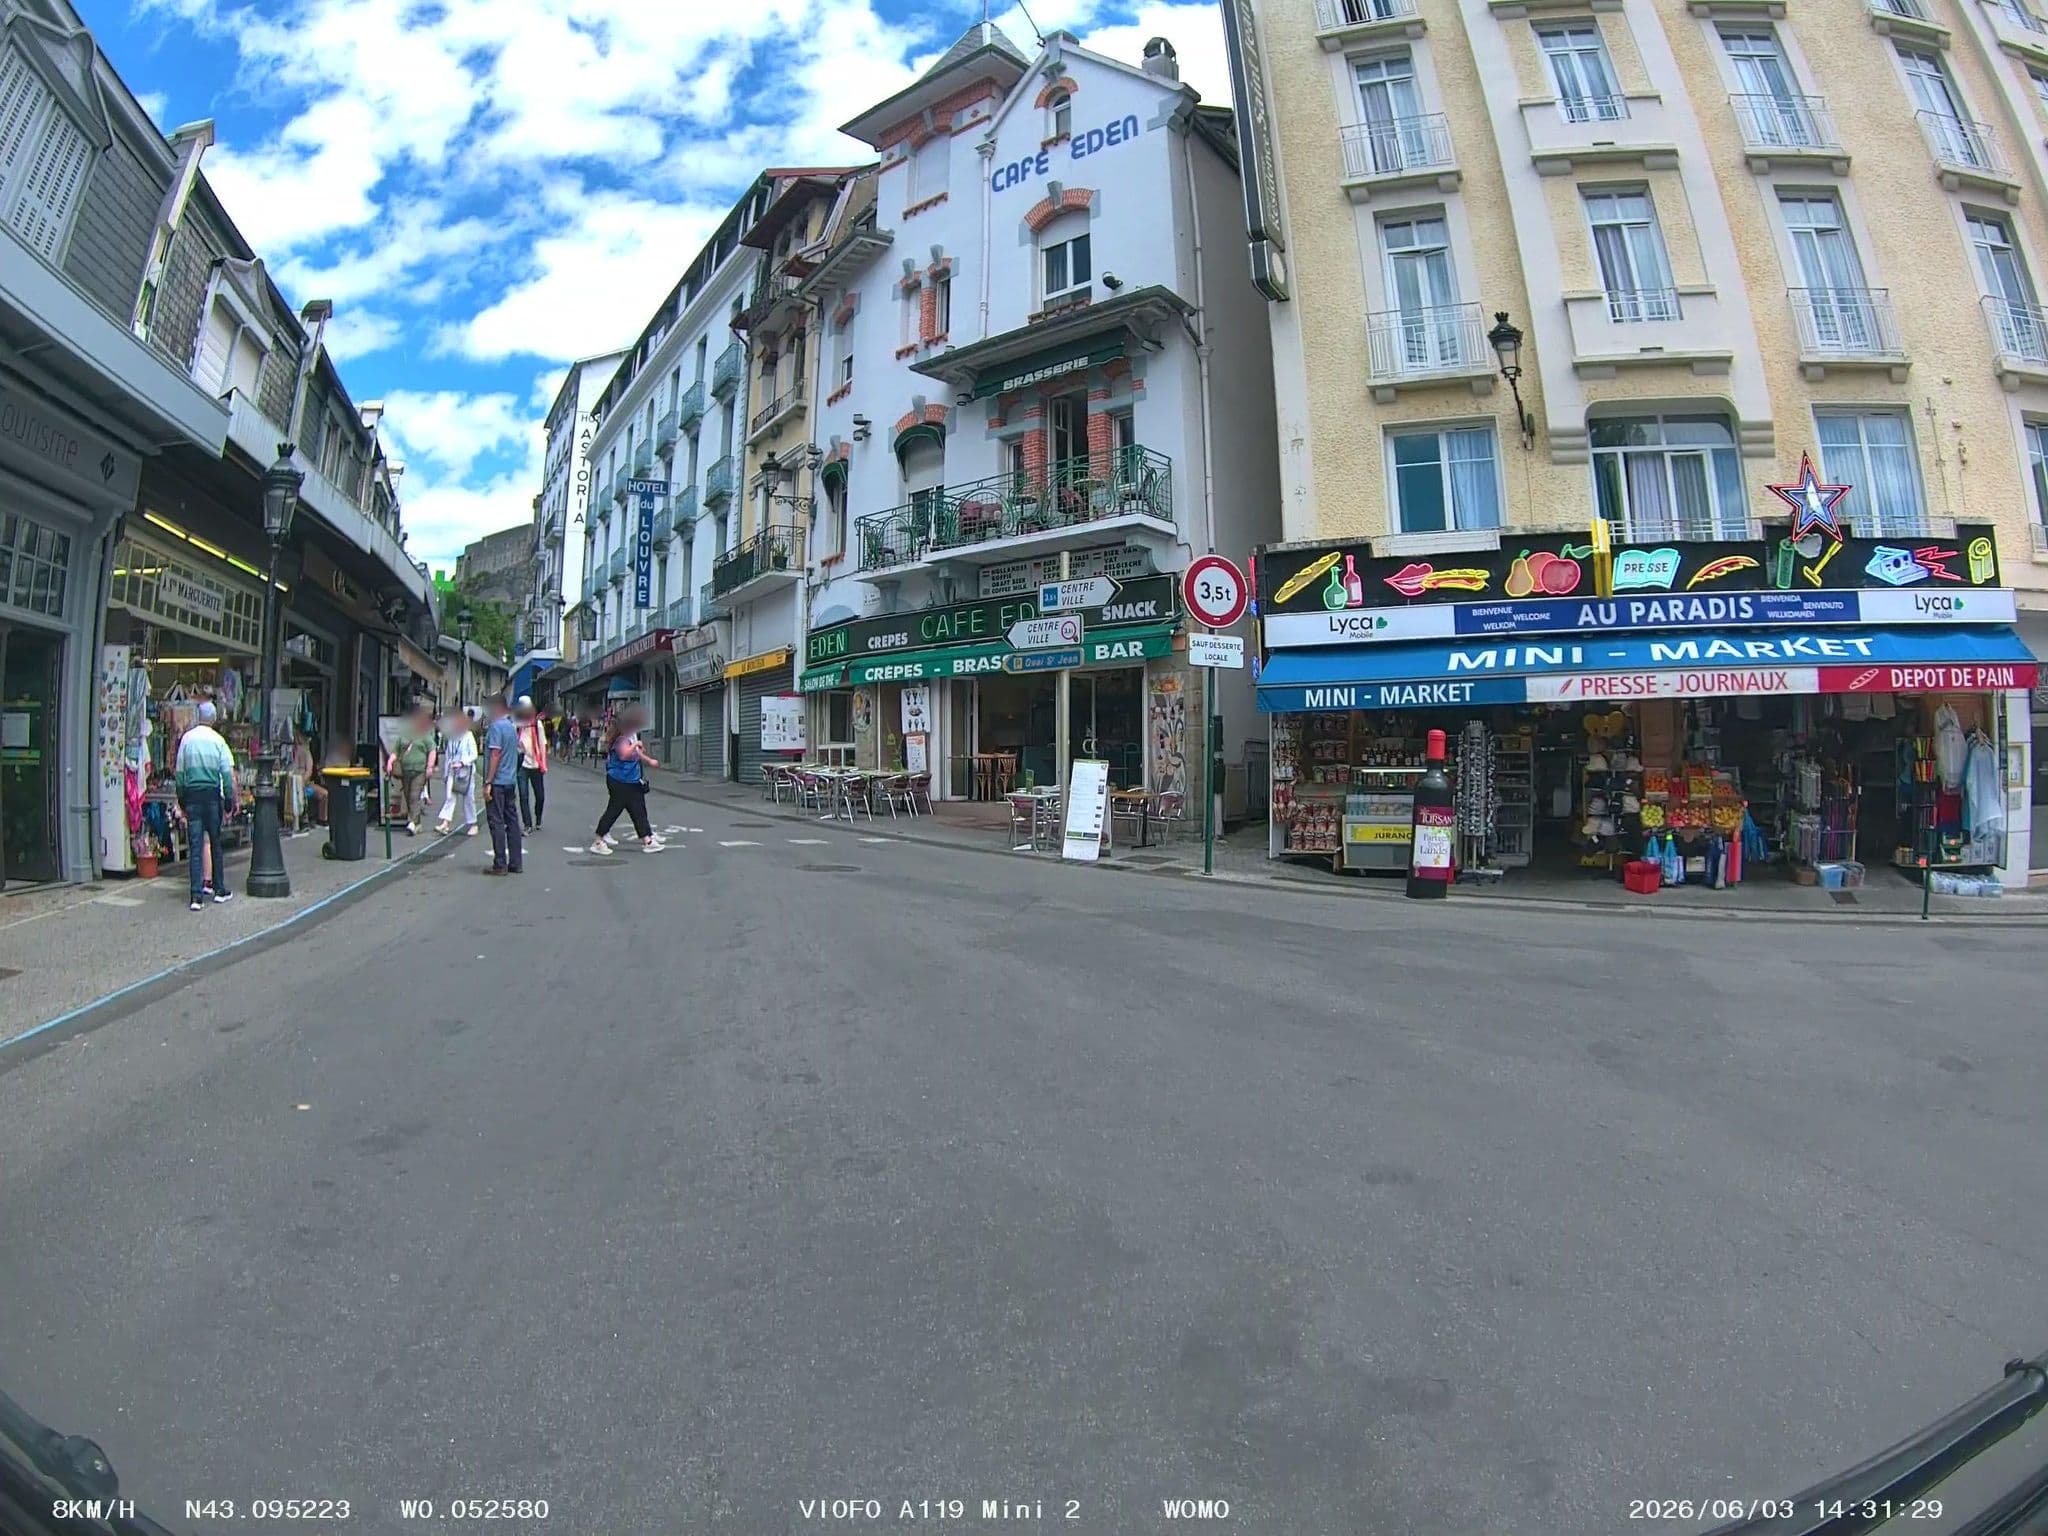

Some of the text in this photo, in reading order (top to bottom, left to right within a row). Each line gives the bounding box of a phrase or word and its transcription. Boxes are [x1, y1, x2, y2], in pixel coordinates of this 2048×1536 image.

[1071, 115, 1139, 160] EDEN
[1003, 356, 1089, 391] BRASSERIE
[1, 404, 80, 466] ourisme
[628, 481, 667, 494] HOTEL
[640, 499, 654, 510] du
[638, 516, 651, 602] LOUVRE
[1061, 582, 1095, 594] CENTRE
[1062, 595, 1084, 606] VILLE
[1761, 594, 1801, 603] BIENVENIDA
[1915, 593, 1952, 614] Lyca
[1577, 597, 1754, 626] AU PARADIS
[1803, 601, 1844, 610] BENVENUTO
[1472, 607, 1513, 617] BIENVENUE
[1513, 612, 1550, 621] WELCOME
[1767, 610, 1816, 618] WILLKOMMEN
[868, 632, 908, 649] CREPES
[921, 609, 984, 639] CAFE
[1102, 601, 1157, 621] SNACK
[1027, 621, 1059, 633] CENTRE
[1329, 615, 1373, 634] Lyca
[1483, 621, 1517, 631] WELKOM
[1028, 634, 1049, 644] VILLE
[1350, 631, 1373, 639] Mobile
[810, 632, 845, 659] EDEN
[1095, 641, 1144, 660] BAR
[1192, 640, 1241, 651] SAUF DESSERTE
[1205, 653, 1228, 661] LOCALE
[1447, 646, 1583, 670] MINI
[1650, 636, 1874, 661] MARKET
[1581, 675, 1658, 696] PRESSE
[1676, 671, 1789, 694] JOURNAUX
[1891, 667, 1946, 688] DEPOT
[1951, 667, 1974, 688] DE
[1977, 667, 2014, 687] PAIN
[1305, 688, 1356, 708] MINI
[1380, 683, 1475, 705] MARKET
[1374, 832, 1412, 840] JURANC
